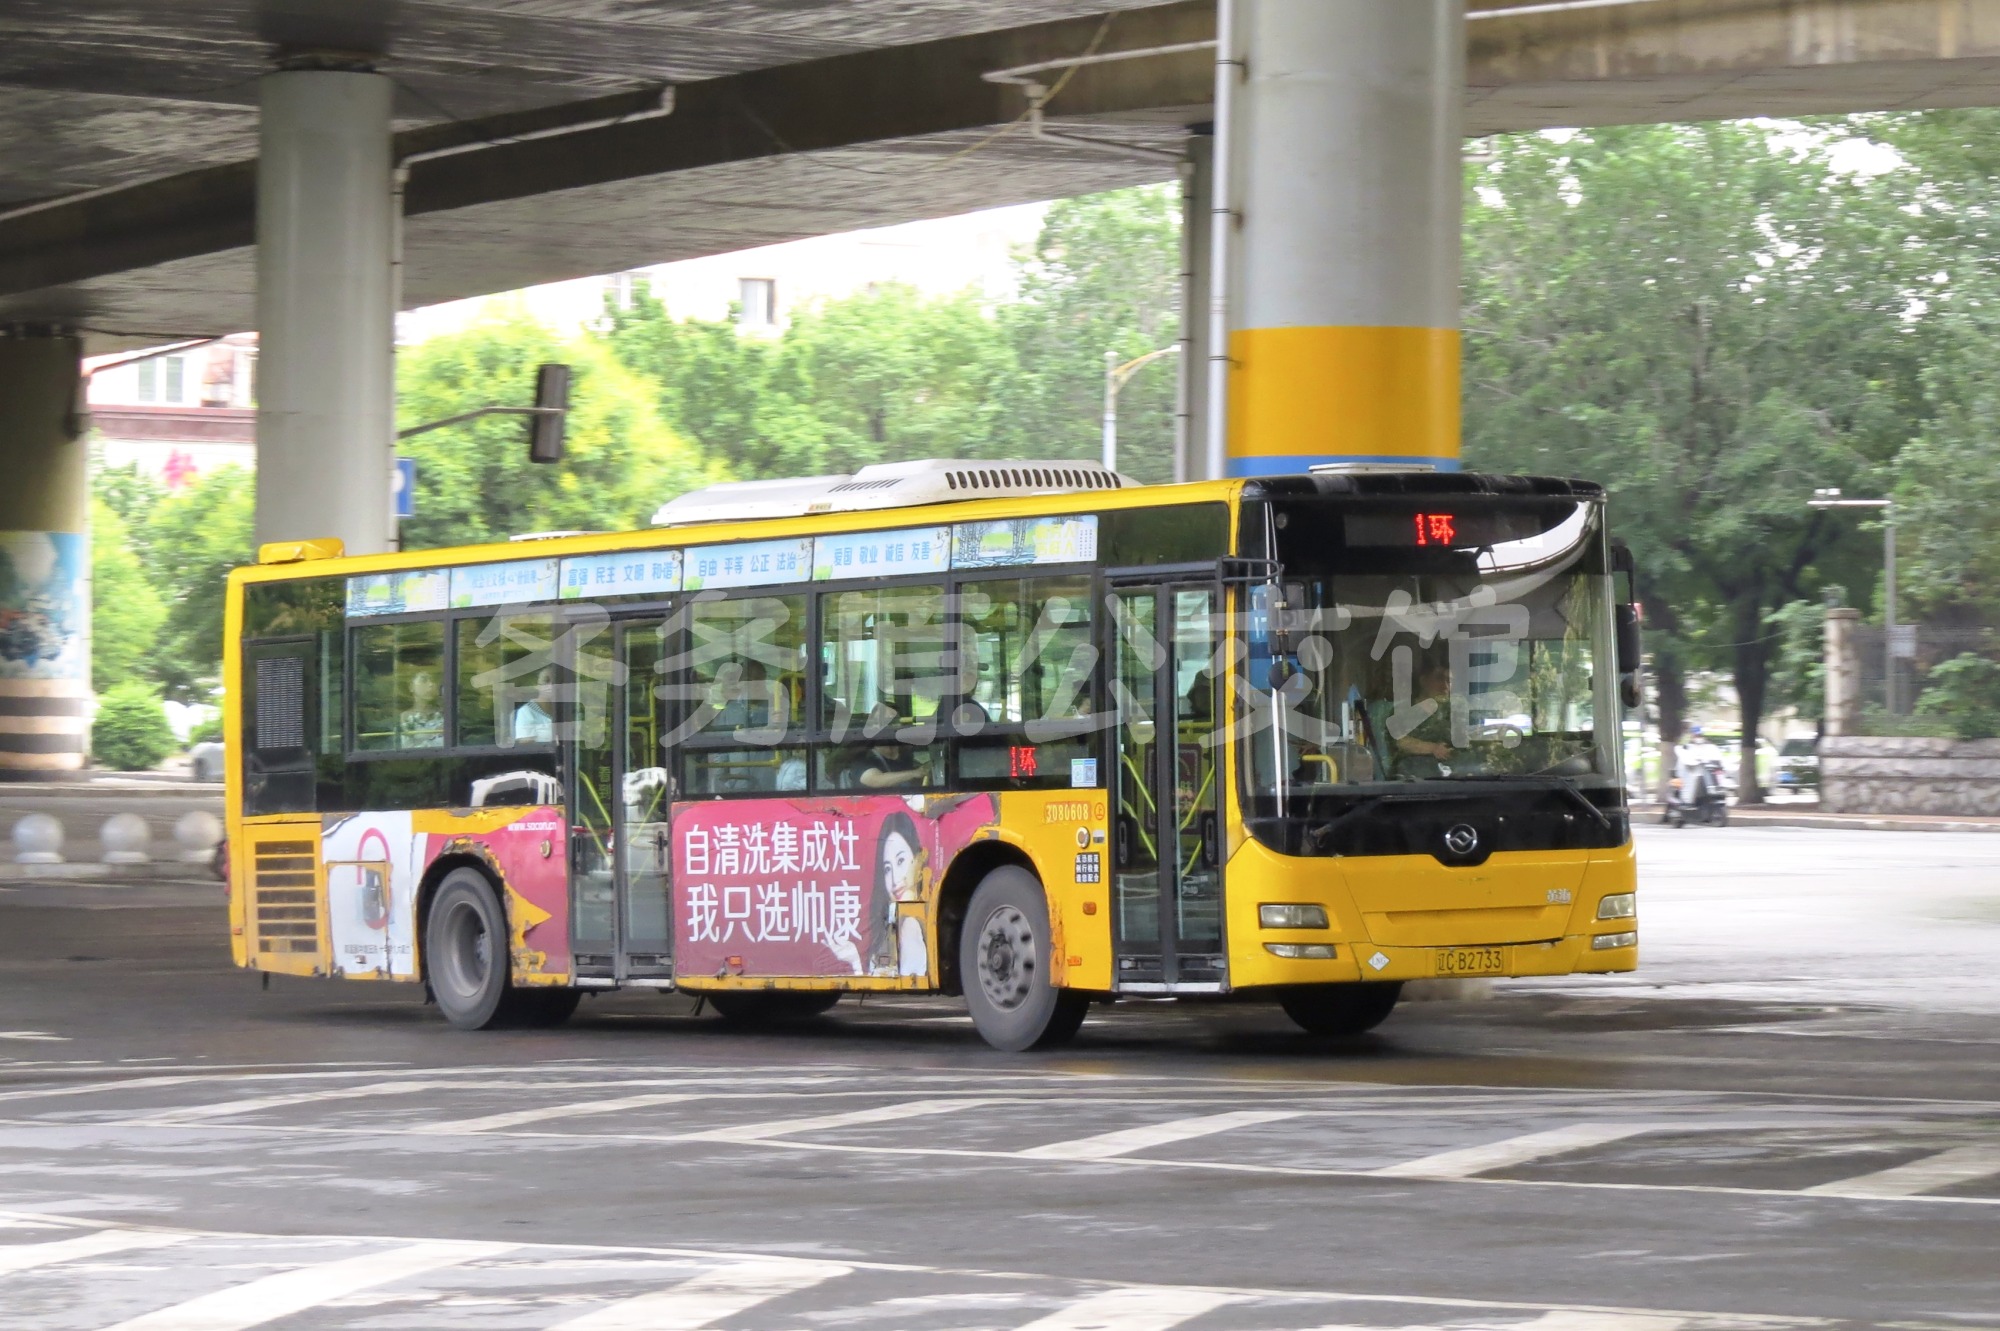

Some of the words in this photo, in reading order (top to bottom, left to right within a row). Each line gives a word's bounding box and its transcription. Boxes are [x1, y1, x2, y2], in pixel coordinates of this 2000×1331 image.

[1415, 513, 1455, 546] 1环
[699, 559, 717, 576] 自由
[724, 556, 743, 575] 平等
[751, 554, 770, 572] 公正
[777, 552, 796, 570] 法治
[835, 547, 852, 566] 爱国
[860, 545, 878, 564] 敬业
[885, 544, 904, 561] 诚信
[911, 541, 930, 560] 友善
[568, 568, 588, 586] 富强
[596, 566, 615, 584] 民主
[624, 564, 645, 581] 文明
[652, 562, 673, 579] 和谐
[1010, 746, 1037, 777] 1环
[685, 820, 860, 875] 自清洗集成灶
[686, 880, 862, 943] 我只选帅康
